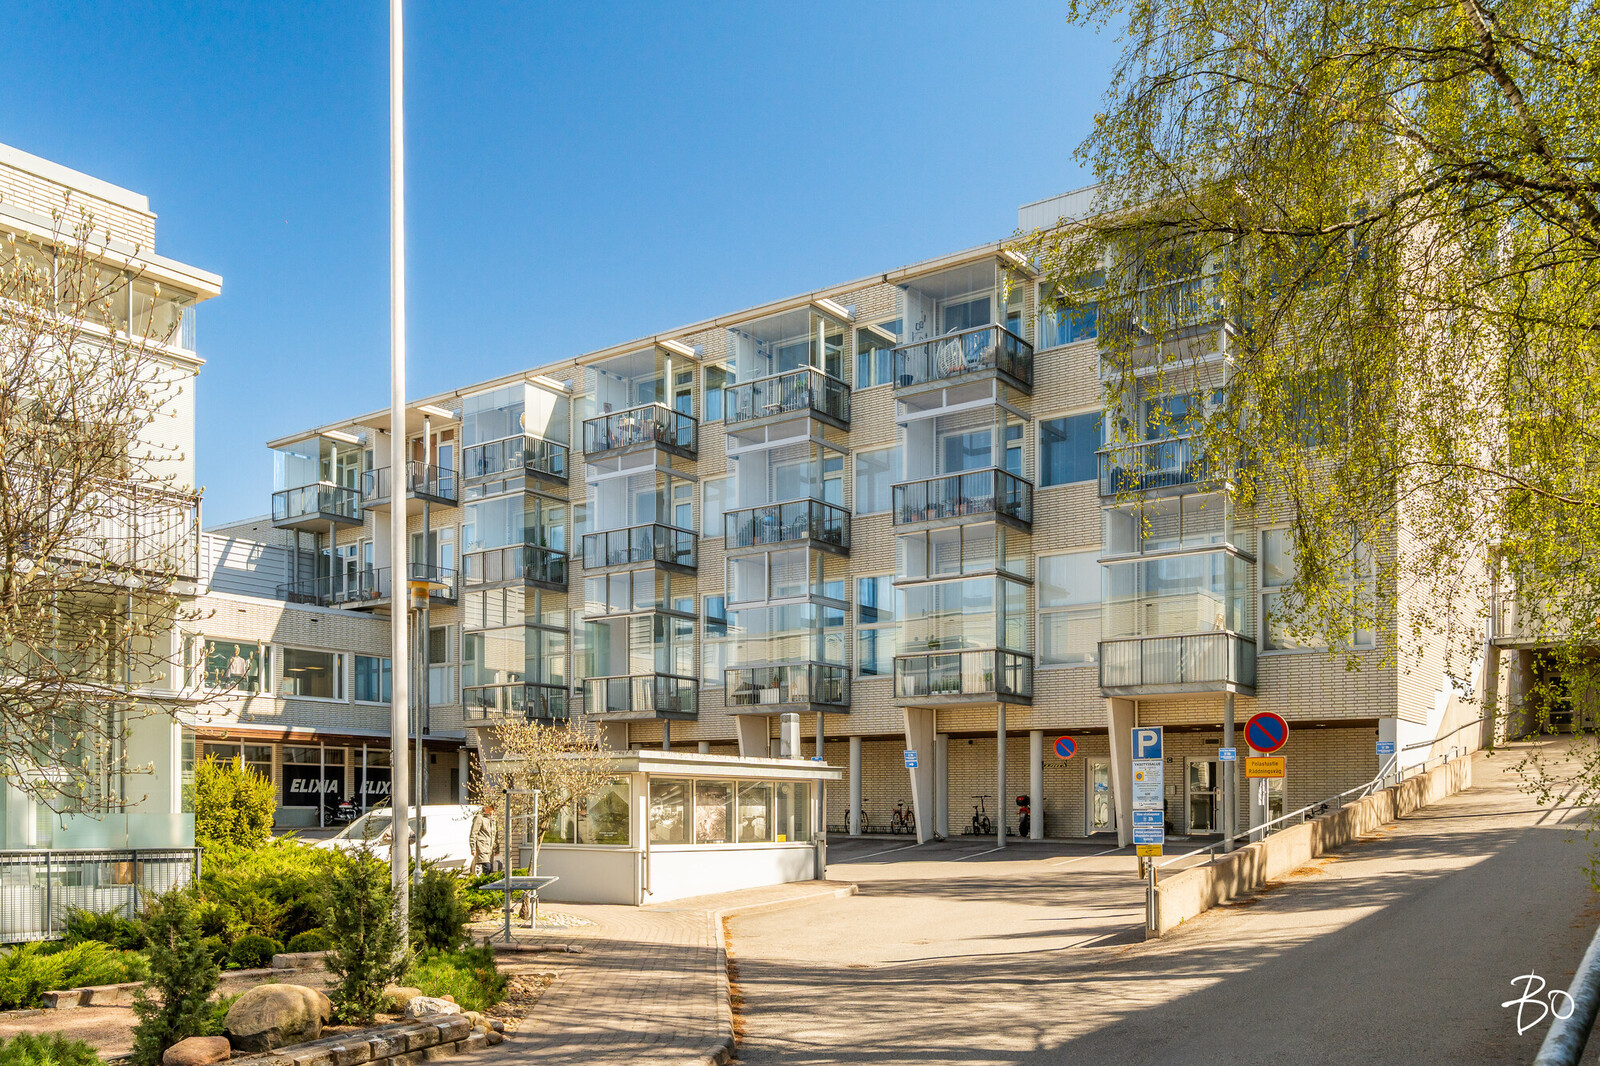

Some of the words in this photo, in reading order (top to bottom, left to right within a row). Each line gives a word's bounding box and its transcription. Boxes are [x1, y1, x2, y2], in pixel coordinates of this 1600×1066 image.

[1138, 730, 1158, 758] P
[290, 778, 338, 793] ELIXIA
[359, 780, 392, 794] ELIX
